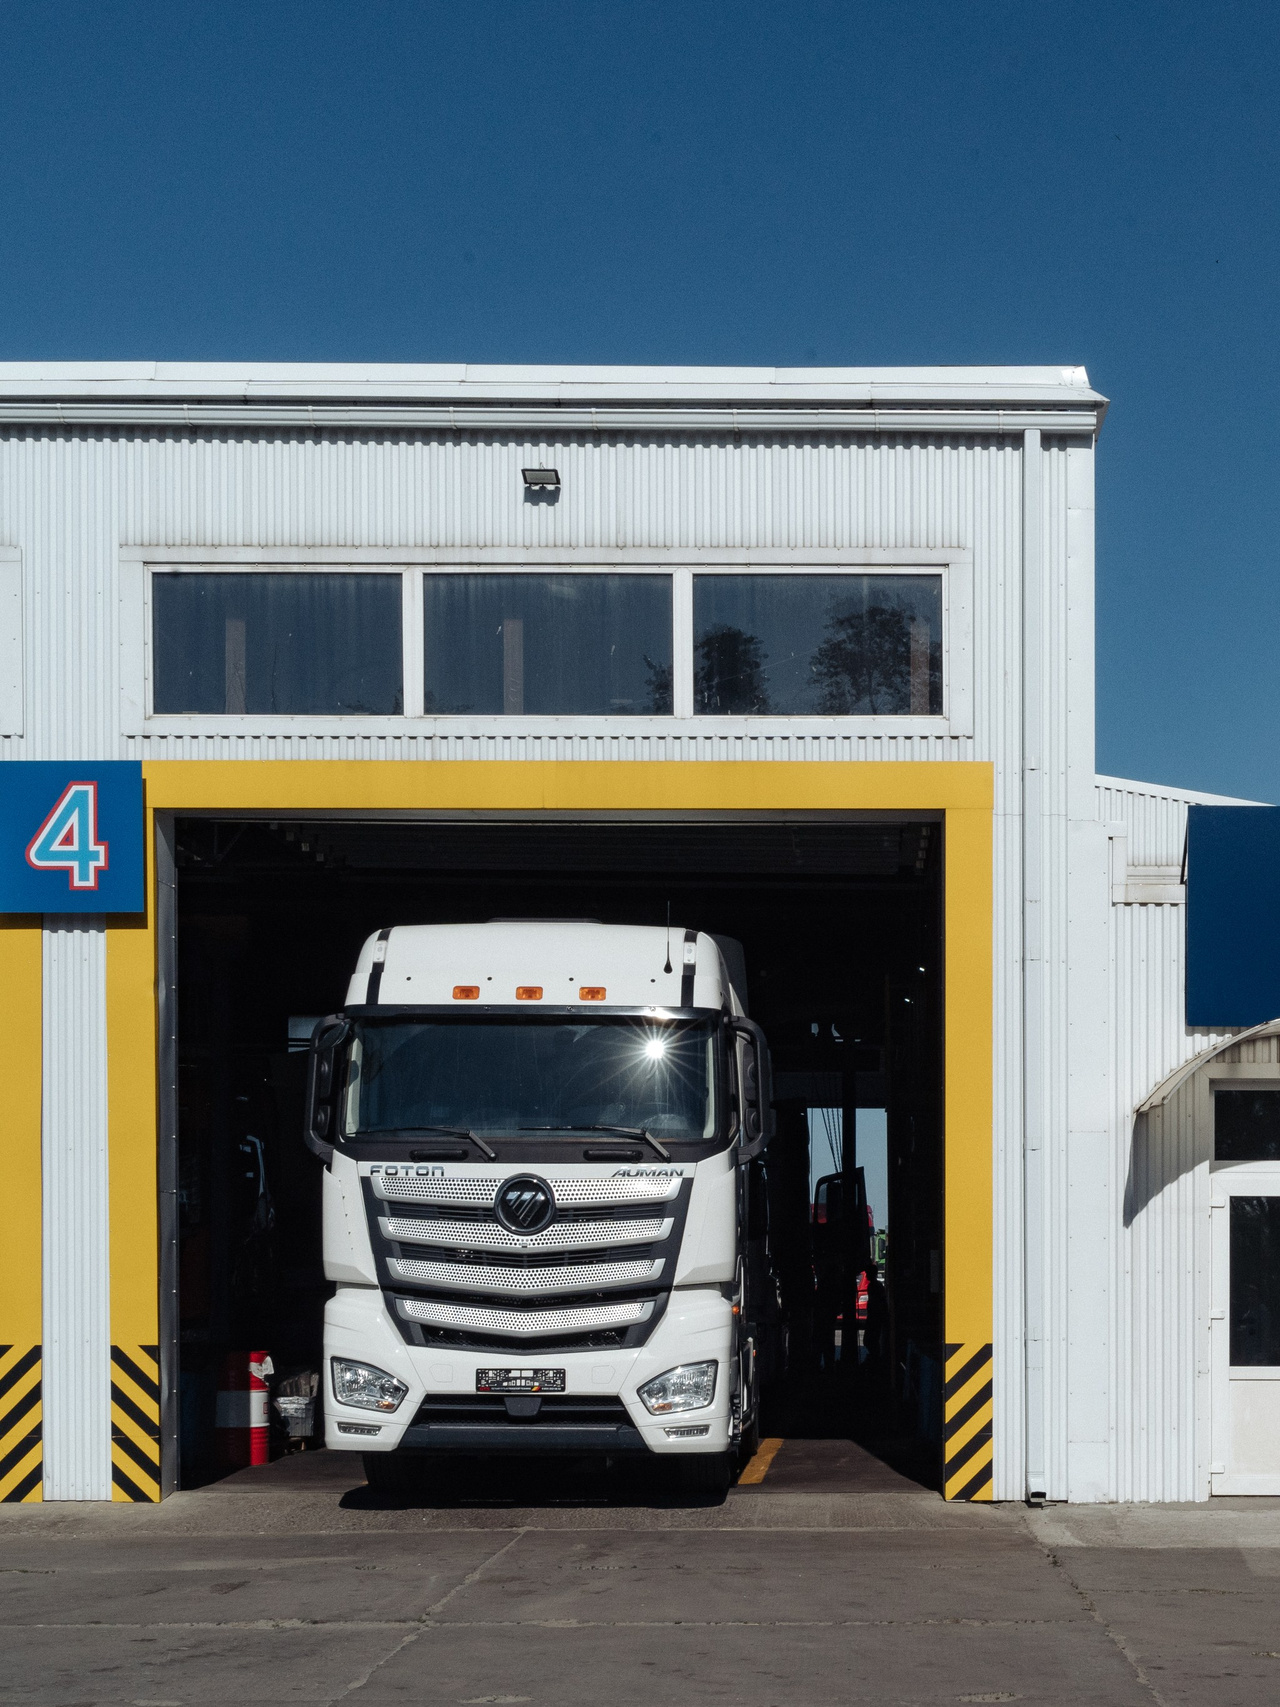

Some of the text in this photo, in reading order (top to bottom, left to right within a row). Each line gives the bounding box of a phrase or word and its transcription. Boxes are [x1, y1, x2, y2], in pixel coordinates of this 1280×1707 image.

[25, 781, 109, 890] 4
[370, 1165, 445, 1177] FOTON
[611, 1167, 685, 1178] AUMAN
